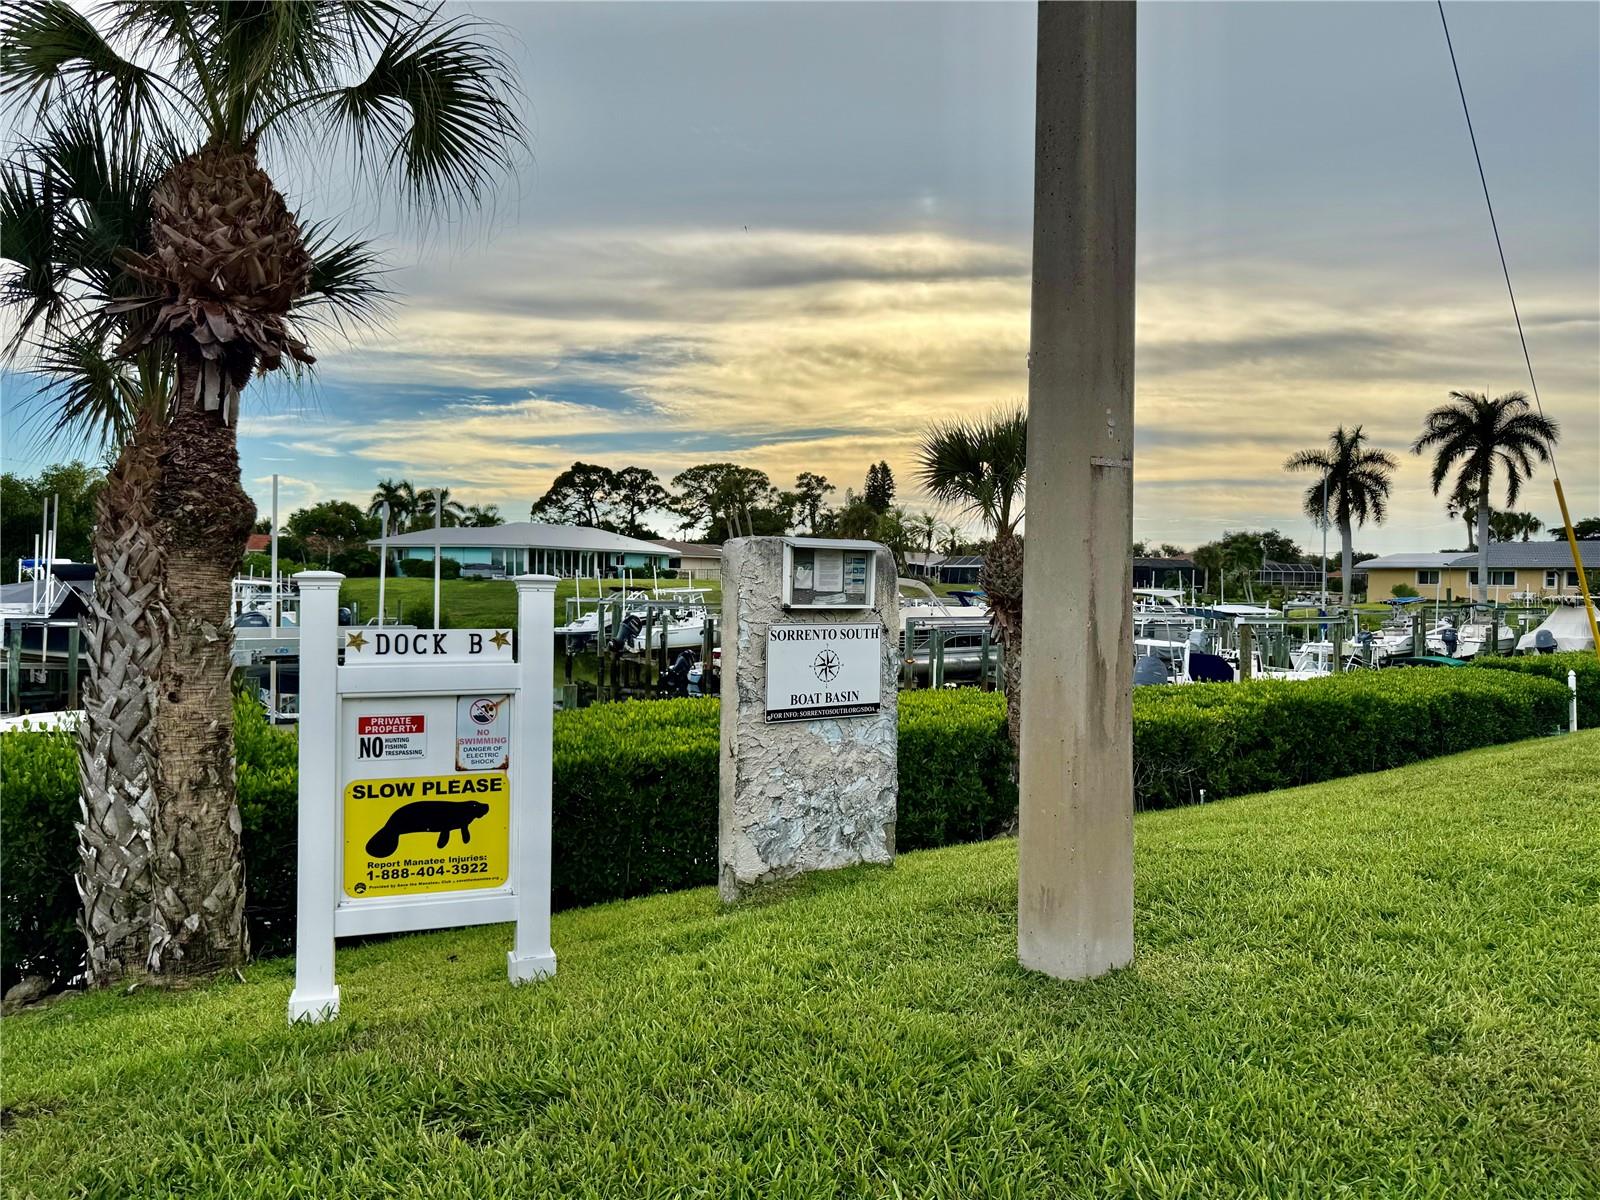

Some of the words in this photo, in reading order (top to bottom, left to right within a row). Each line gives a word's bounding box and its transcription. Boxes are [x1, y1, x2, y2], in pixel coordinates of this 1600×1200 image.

[770, 629, 837, 641] SORRENTO
[840, 628, 879, 640] SOUTH
[375, 633, 447, 655] DOCK
[469, 634, 483, 654] B
[790, 693, 822, 705] BOAT
[825, 690, 859, 703] BASIN
[370, 717, 412, 725] PRIVATE
[365, 725, 417, 733] PROPERTY
[360, 737, 383, 758] NO
[459, 737, 507, 745] SWIMMING
[352, 782, 415, 799] SLOW
[422, 778, 502, 795] PLEASE
[367, 860, 400, 869] Report
[404, 858, 445, 866] Manatee
[449, 855, 487, 864] Injuries:
[366, 863, 488, 881] 1-888-404-3922
